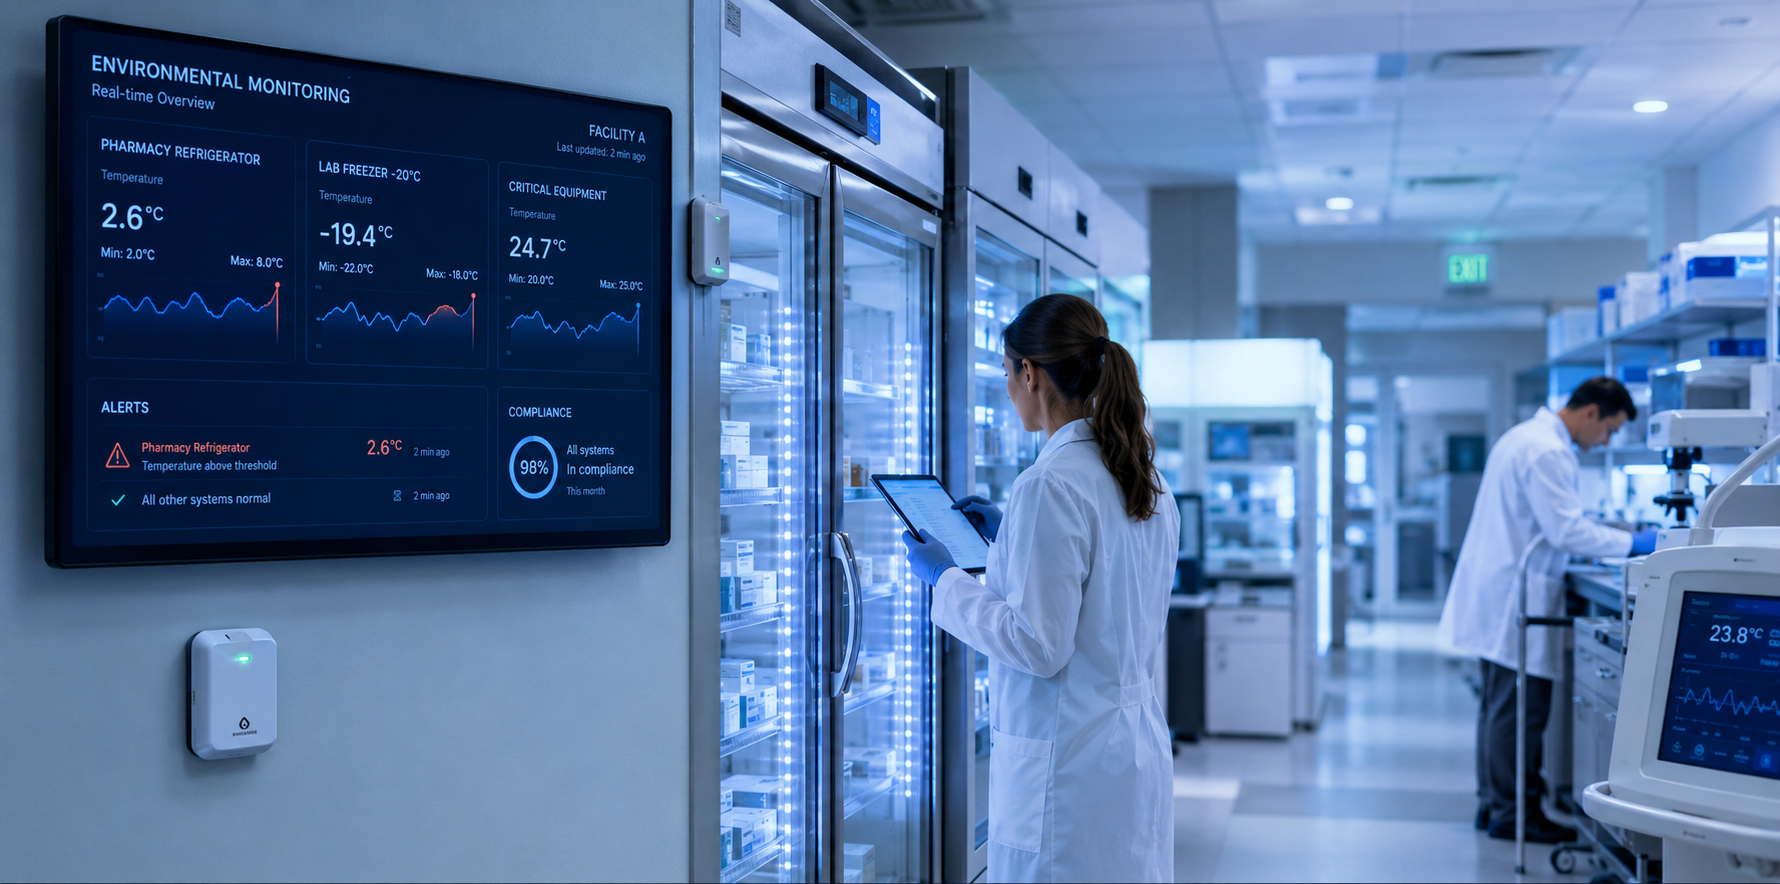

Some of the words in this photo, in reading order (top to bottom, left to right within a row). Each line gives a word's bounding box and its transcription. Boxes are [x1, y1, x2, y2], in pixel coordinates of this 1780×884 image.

[91, 54, 243, 90] ENVIRONMENTAL
[248, 75, 350, 104] MONITORING
[91, 83, 154, 103] Real-time
[157, 91, 216, 110] Overview
[589, 124, 636, 143] FACILITY
[638, 131, 646, 144] A
[101, 138, 171, 157] PHARMACY
[174, 145, 261, 166] REFRIGERATOR
[556, 141, 574, 153] Last
[575, 144, 609, 157] updated:
[610, 148, 616, 158] 2
[616, 150, 631, 160] min
[631, 153, 646, 164] ago
[318, 160, 340, 174] LAB
[342, 163, 388, 178] FREEZER
[101, 169, 164, 185] Temperature
[318, 189, 373, 205] Temperature
[508, 180, 551, 196] CRITICAL
[553, 185, 607, 201] EQUIPMENT
[509, 207, 556, 221] Temperature
[101, 246, 123, 259] Min:
[230, 255, 254, 267] Max:
[318, 261, 338, 272] Min:
[426, 268, 446, 279] Max:
[1448, 254, 1490, 283] EXIT
[508, 273, 526, 284] Min:
[599, 279, 618, 290] Max:
[101, 401, 149, 414] ALERTS
[508, 406, 572, 418] COMPLIANCE
[141, 442, 191, 455] Pharmacy
[193, 442, 251, 455] Refrigerator
[413, 447, 419, 457] 2
[420, 446, 434, 457] min
[436, 448, 450, 459] ago
[566, 444, 578, 455] All
[579, 445, 615, 457] systems
[142, 460, 202, 473] Temperature
[204, 460, 233, 472] above
[234, 460, 277, 472] threshold
[520, 459, 549, 475] 98%
[566, 463, 576, 475] In
[579, 463, 635, 477] compliance
[413, 491, 419, 500] 2
[420, 491, 434, 500] min
[436, 492, 450, 502] ago
[566, 486, 582, 496] This
[583, 486, 606, 496] month
[141, 494, 156, 506] All
[158, 494, 188, 506] other
[190, 493, 234, 508] systems
[235, 492, 271, 505] normal
